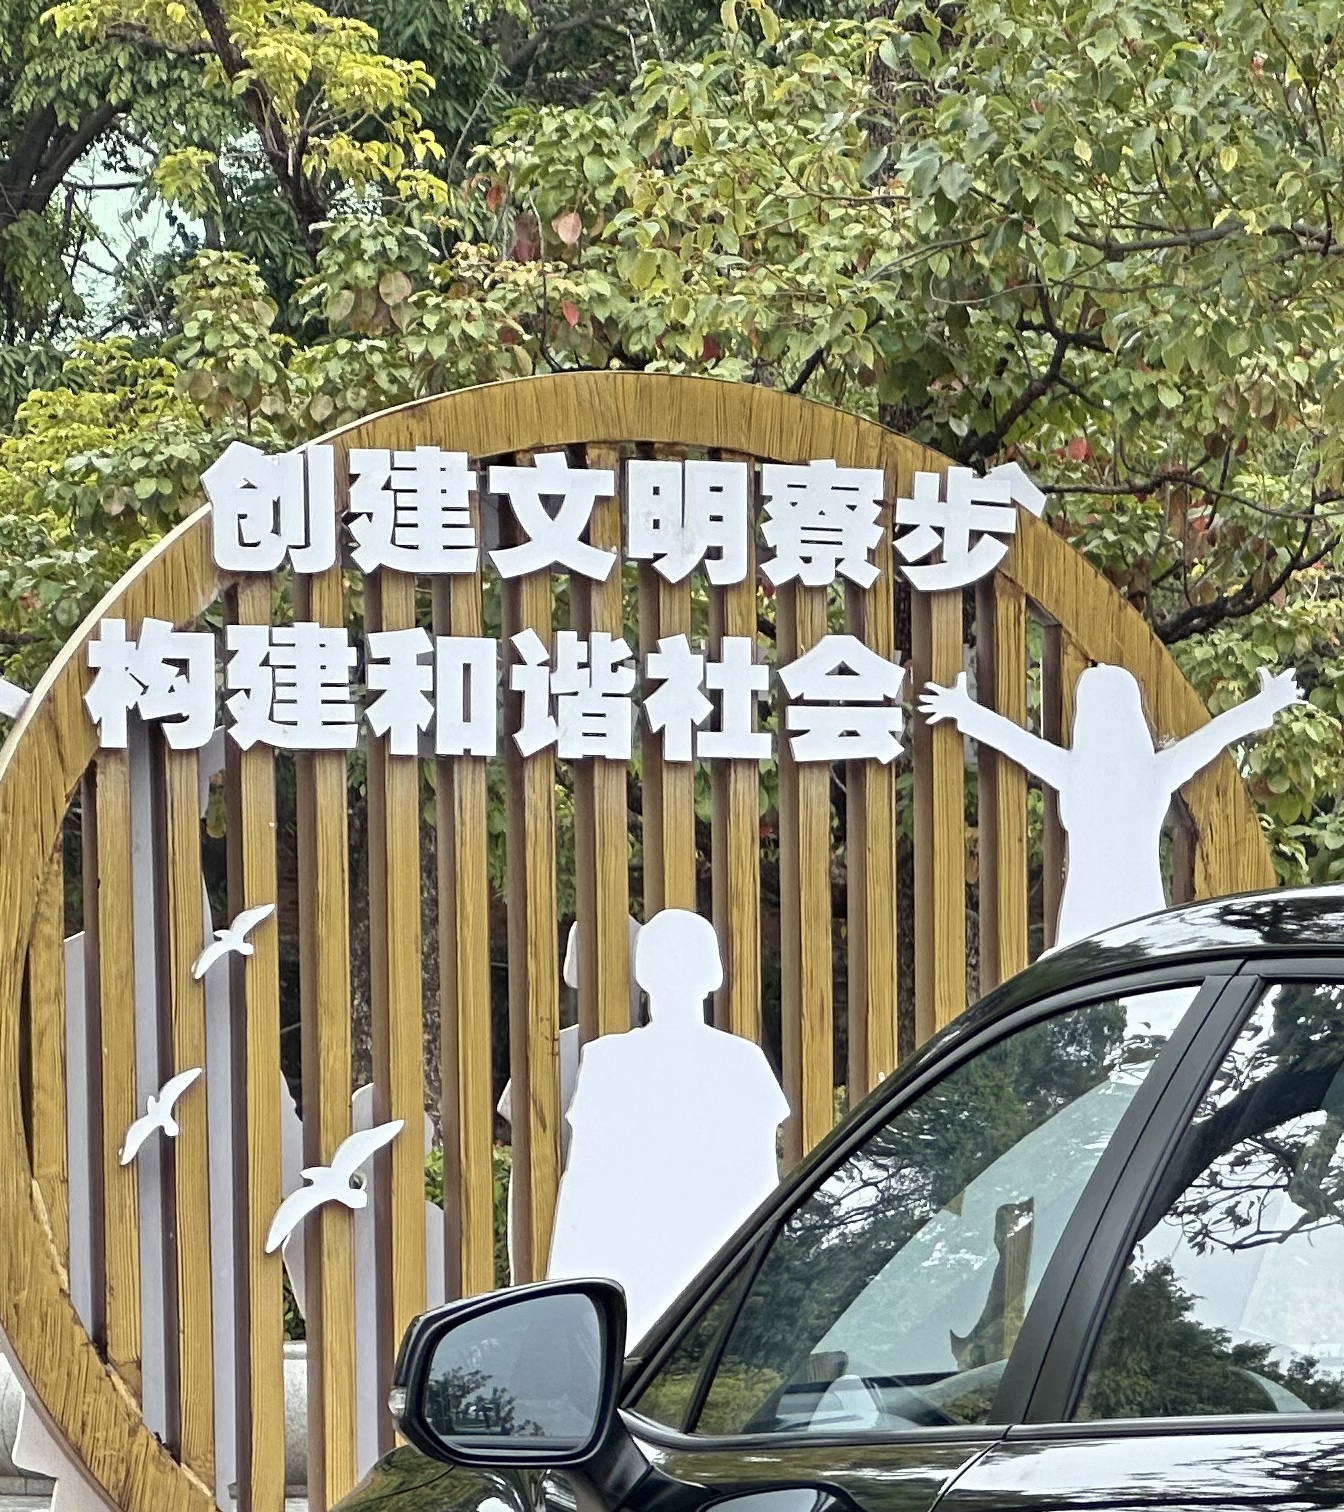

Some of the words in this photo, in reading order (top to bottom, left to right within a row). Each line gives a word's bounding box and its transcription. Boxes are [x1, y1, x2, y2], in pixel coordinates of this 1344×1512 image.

[200, 440, 1018, 592] 创建文明寮步
[84, 617, 906, 765] 构建和谐社会
